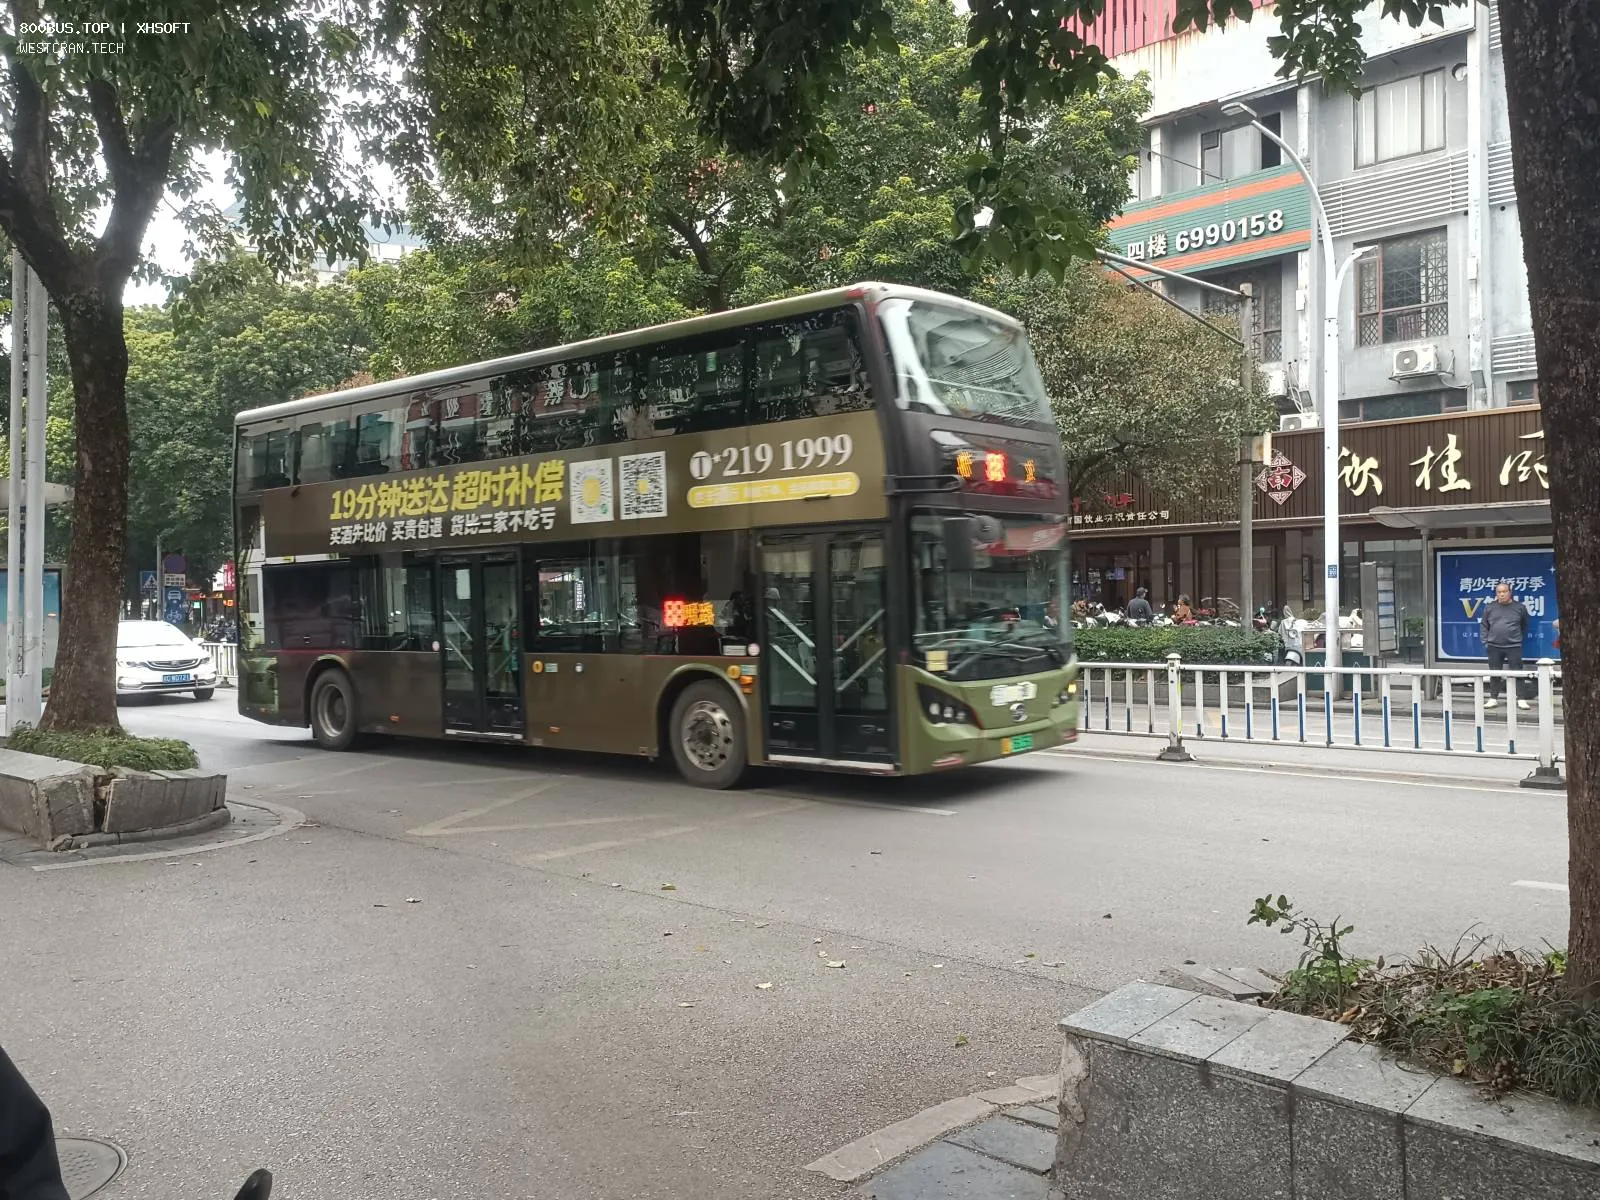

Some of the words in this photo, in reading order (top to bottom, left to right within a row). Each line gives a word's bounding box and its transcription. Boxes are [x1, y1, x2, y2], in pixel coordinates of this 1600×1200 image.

[1127, 231, 1168, 260] 四楼
[1175, 209, 1284, 252] 6990158
[722, 443, 774, 477] 219
[779, 433, 853, 471] 1999
[329, 473, 449, 521] 19分钟送达
[450, 459, 566, 512] 超时补偿
[391, 517, 443, 542] 买贵包退
[450, 506, 557, 537] 货比三家不吃亏
